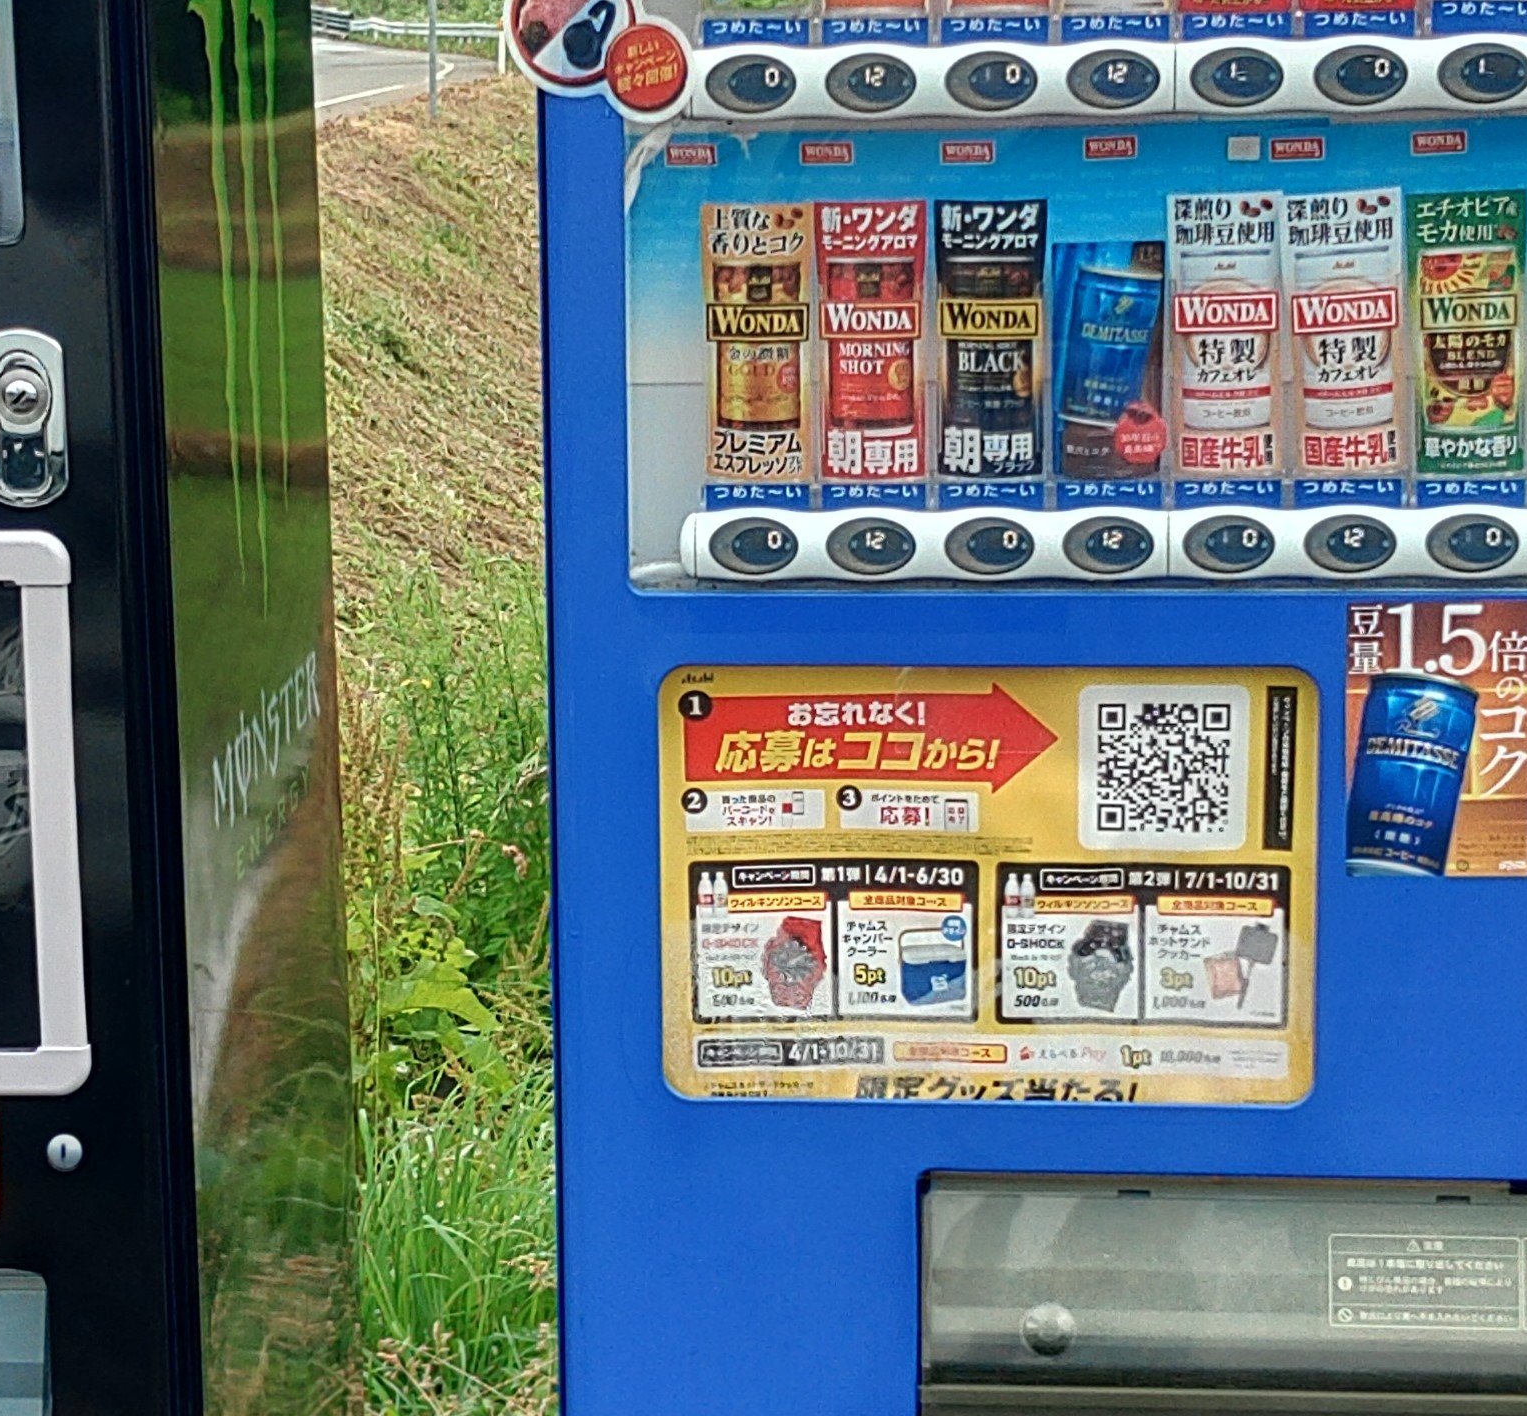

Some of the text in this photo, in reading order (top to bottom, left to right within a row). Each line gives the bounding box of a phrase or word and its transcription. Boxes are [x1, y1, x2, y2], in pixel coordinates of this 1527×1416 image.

[710, 308, 802, 333] WONDA
[1198, 338, 1256, 365] 特製
[839, 358, 884, 376] SHOT
[714, 431, 803, 455] プレミアム
[827, 430, 918, 474] 朝専用
[1180, 436, 1264, 468] 国産牛乳
[1385, 602, 1486, 676] 1.5
[787, 701, 927, 726] お忘れなく!
[715, 730, 999, 772] 応募はココから!
[874, 866, 964, 885] 4/1-6/30
